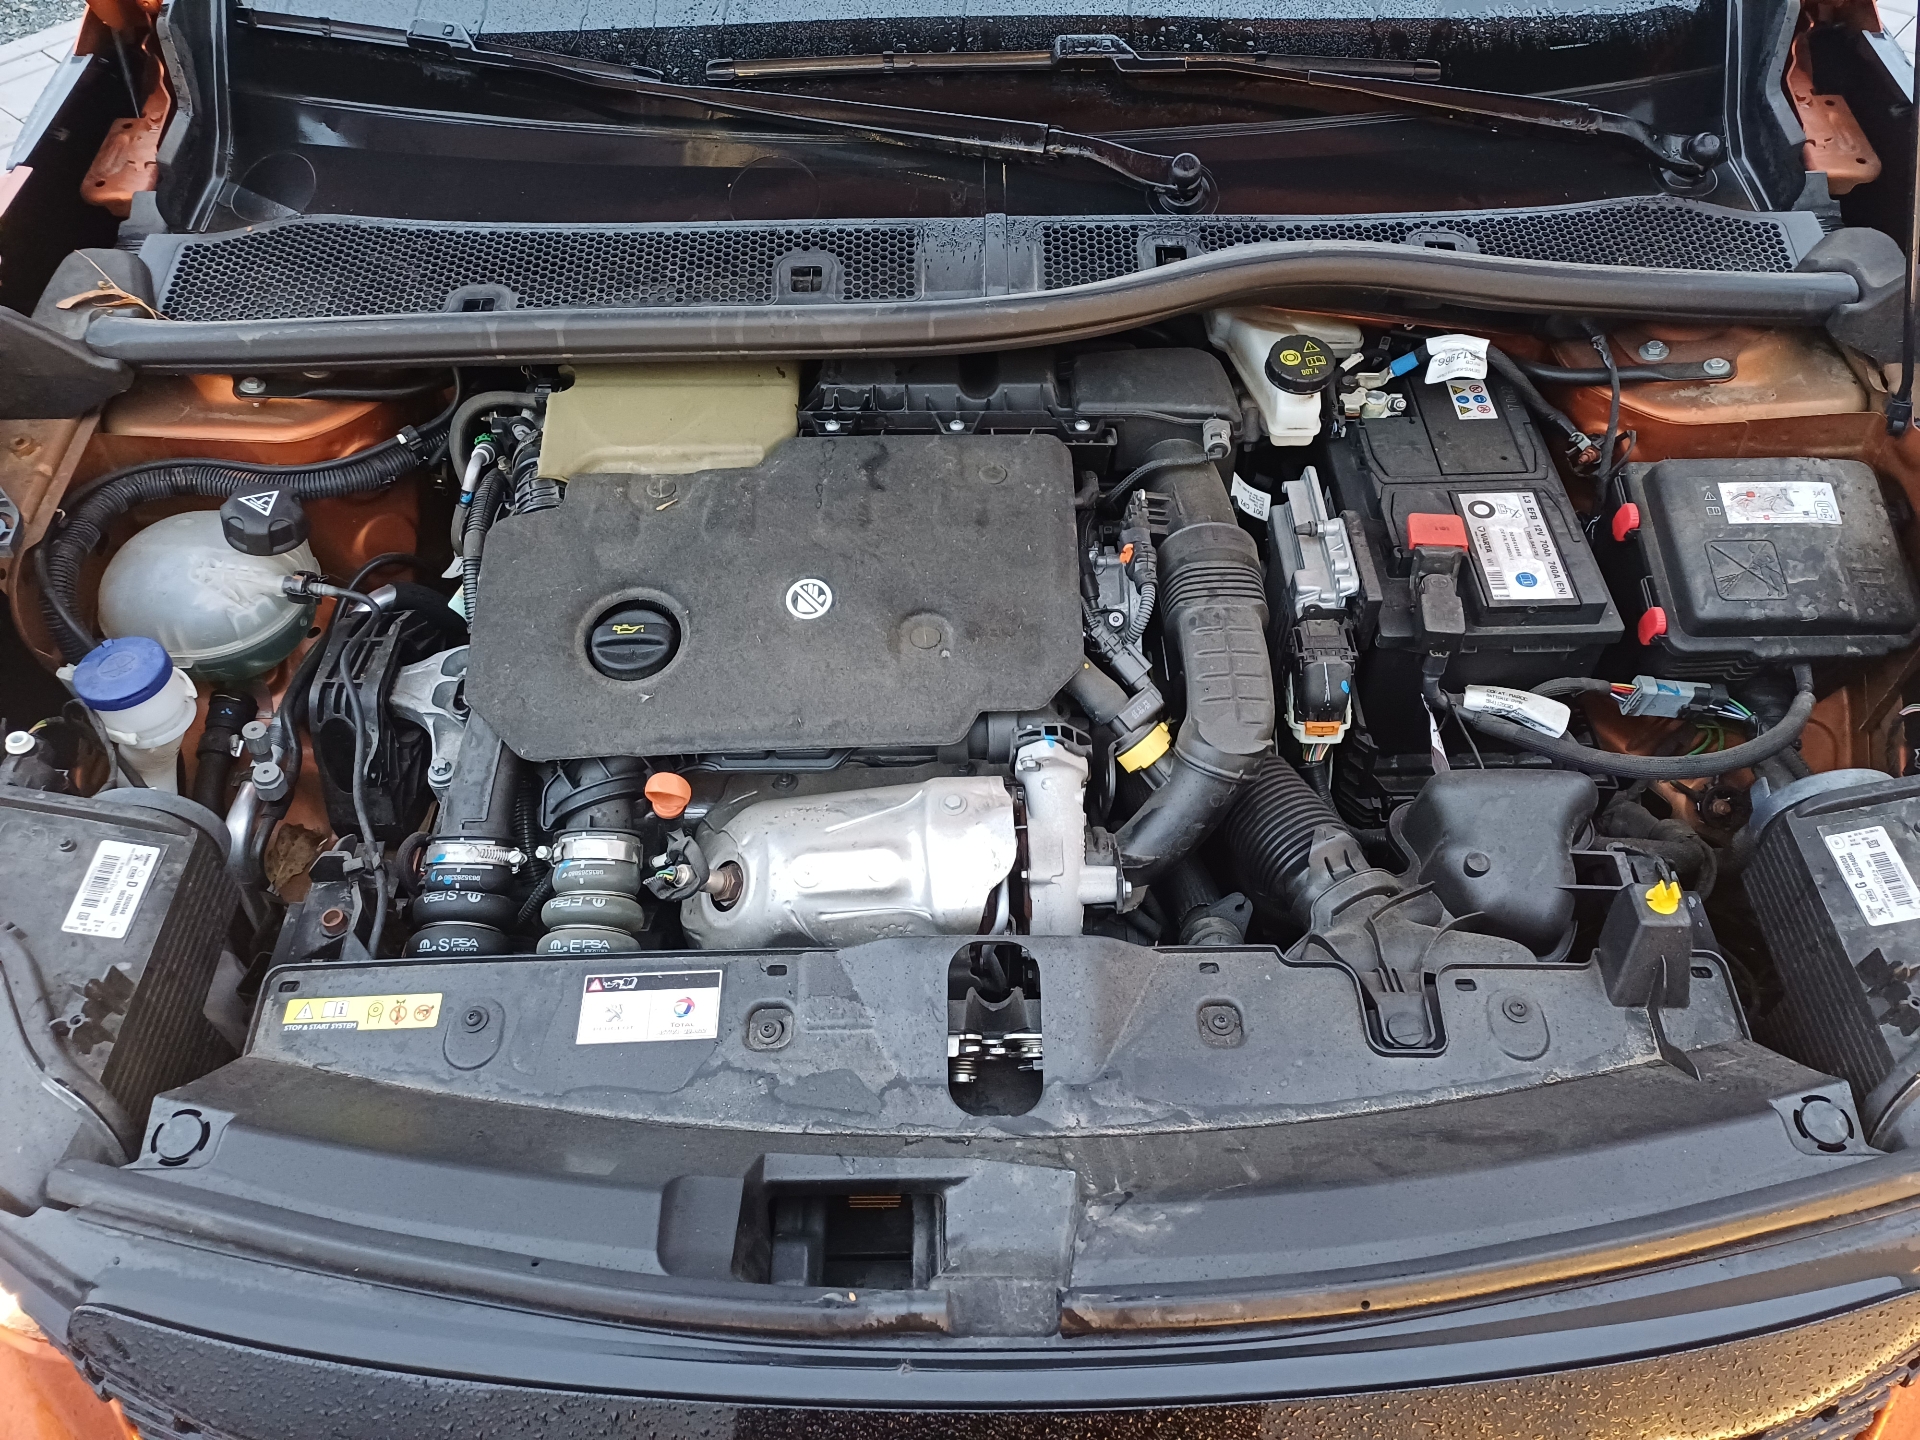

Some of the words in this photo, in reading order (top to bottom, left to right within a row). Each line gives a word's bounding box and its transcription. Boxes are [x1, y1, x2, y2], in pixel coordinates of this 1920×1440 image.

[1480, 532, 1493, 553] VARTA
[1522, 495, 1531, 504] L3
[1527, 507, 1538, 520] EFB
[1534, 524, 1545, 537] 12V
[1540, 540, 1551, 558] 70Ah
[1554, 580, 1567, 595] (EN)
[1854, 881, 1867, 889] G
[423, 892, 446, 904] PSA
[550, 898, 571, 909] PSA
[450, 937, 479, 948] PSA
[569, 939, 581, 953] E
[582, 939, 610, 949] PSA
[330, 1022, 357, 1030] SYSTEM
